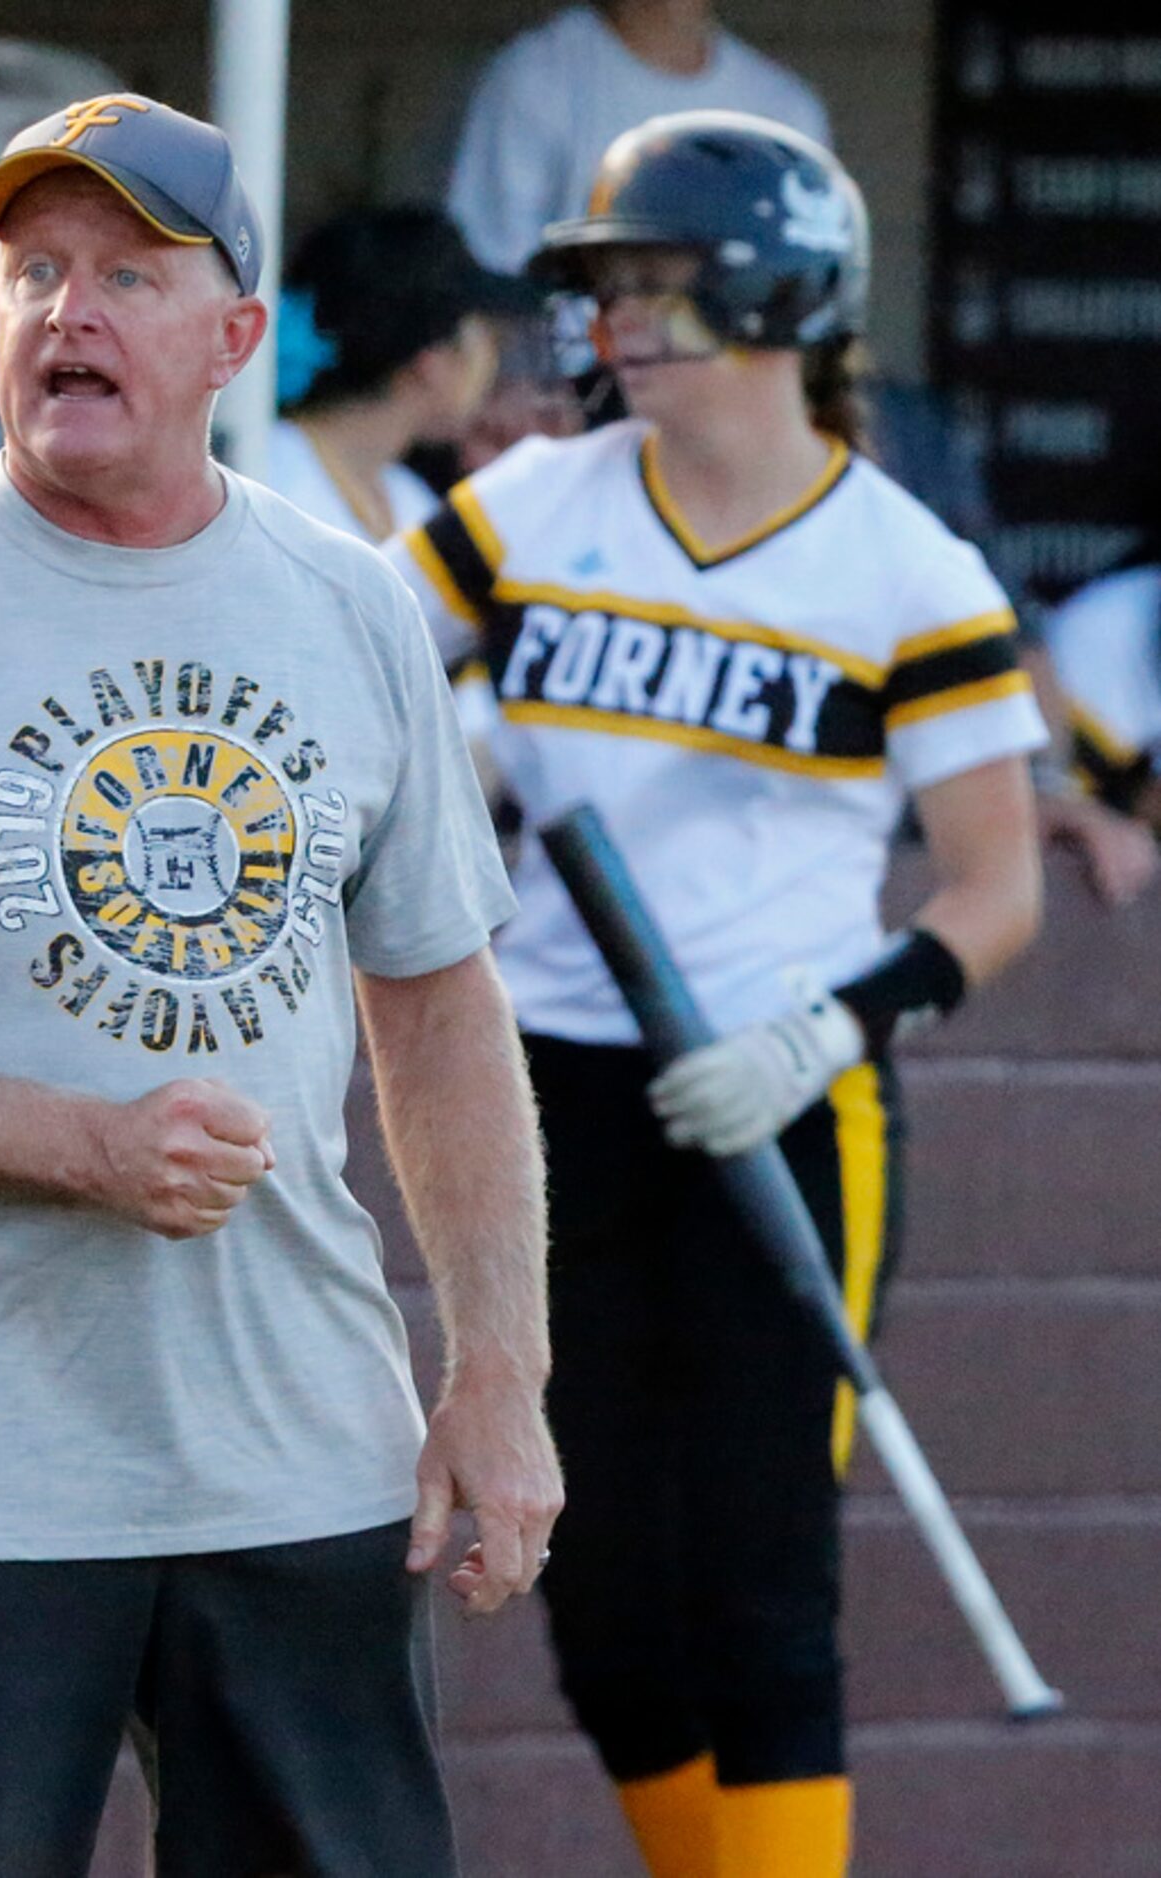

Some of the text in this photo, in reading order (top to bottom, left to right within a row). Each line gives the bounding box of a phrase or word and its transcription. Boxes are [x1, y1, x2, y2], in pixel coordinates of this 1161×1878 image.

[8, 659, 328, 783] PLAYOFFS
[500, 602, 843, 754] FORNEY
[75, 742, 289, 842] FORNEY
[76, 860, 286, 972] SOFTBALL
[291, 787, 348, 948] 2019
[29, 931, 312, 1055] PLAYOFFS
